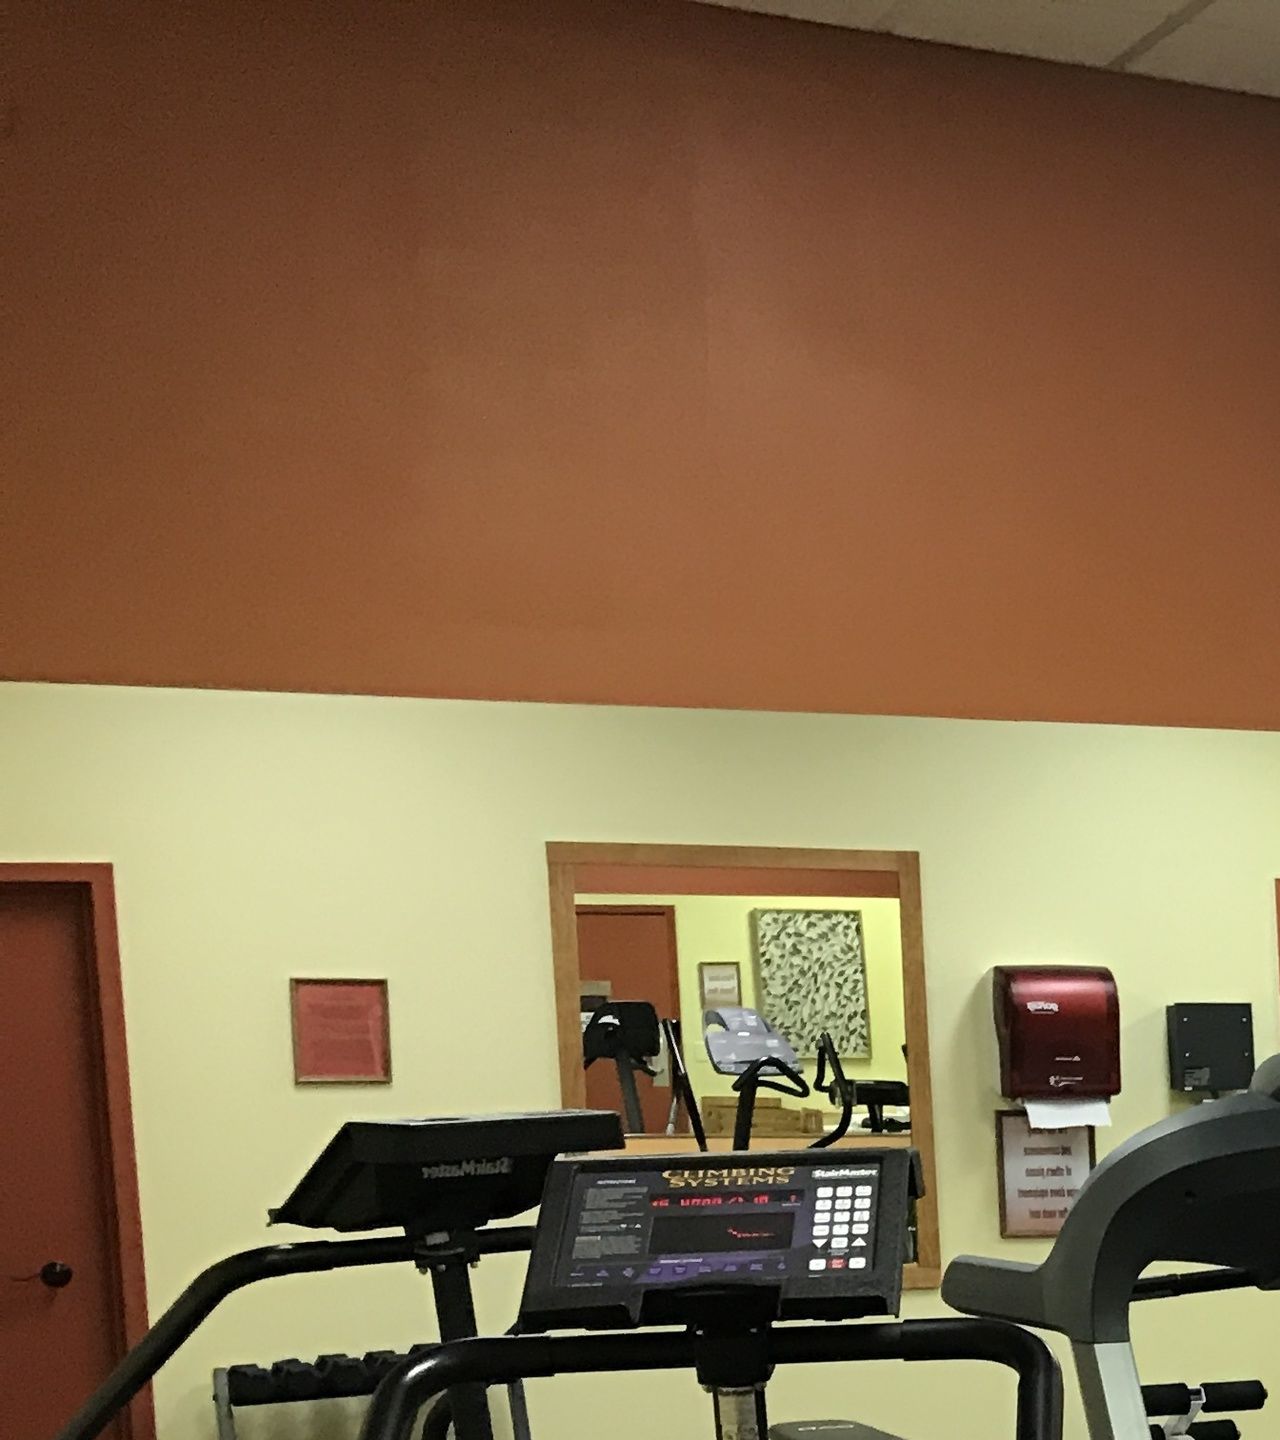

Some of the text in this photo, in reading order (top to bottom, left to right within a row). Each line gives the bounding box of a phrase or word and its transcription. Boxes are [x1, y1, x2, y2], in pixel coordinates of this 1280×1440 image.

[661, 1166, 796, 1180] CLIMBING
[814, 1168, 878, 1179] StairMaster
[668, 1176, 790, 1189] SYSTEMS
